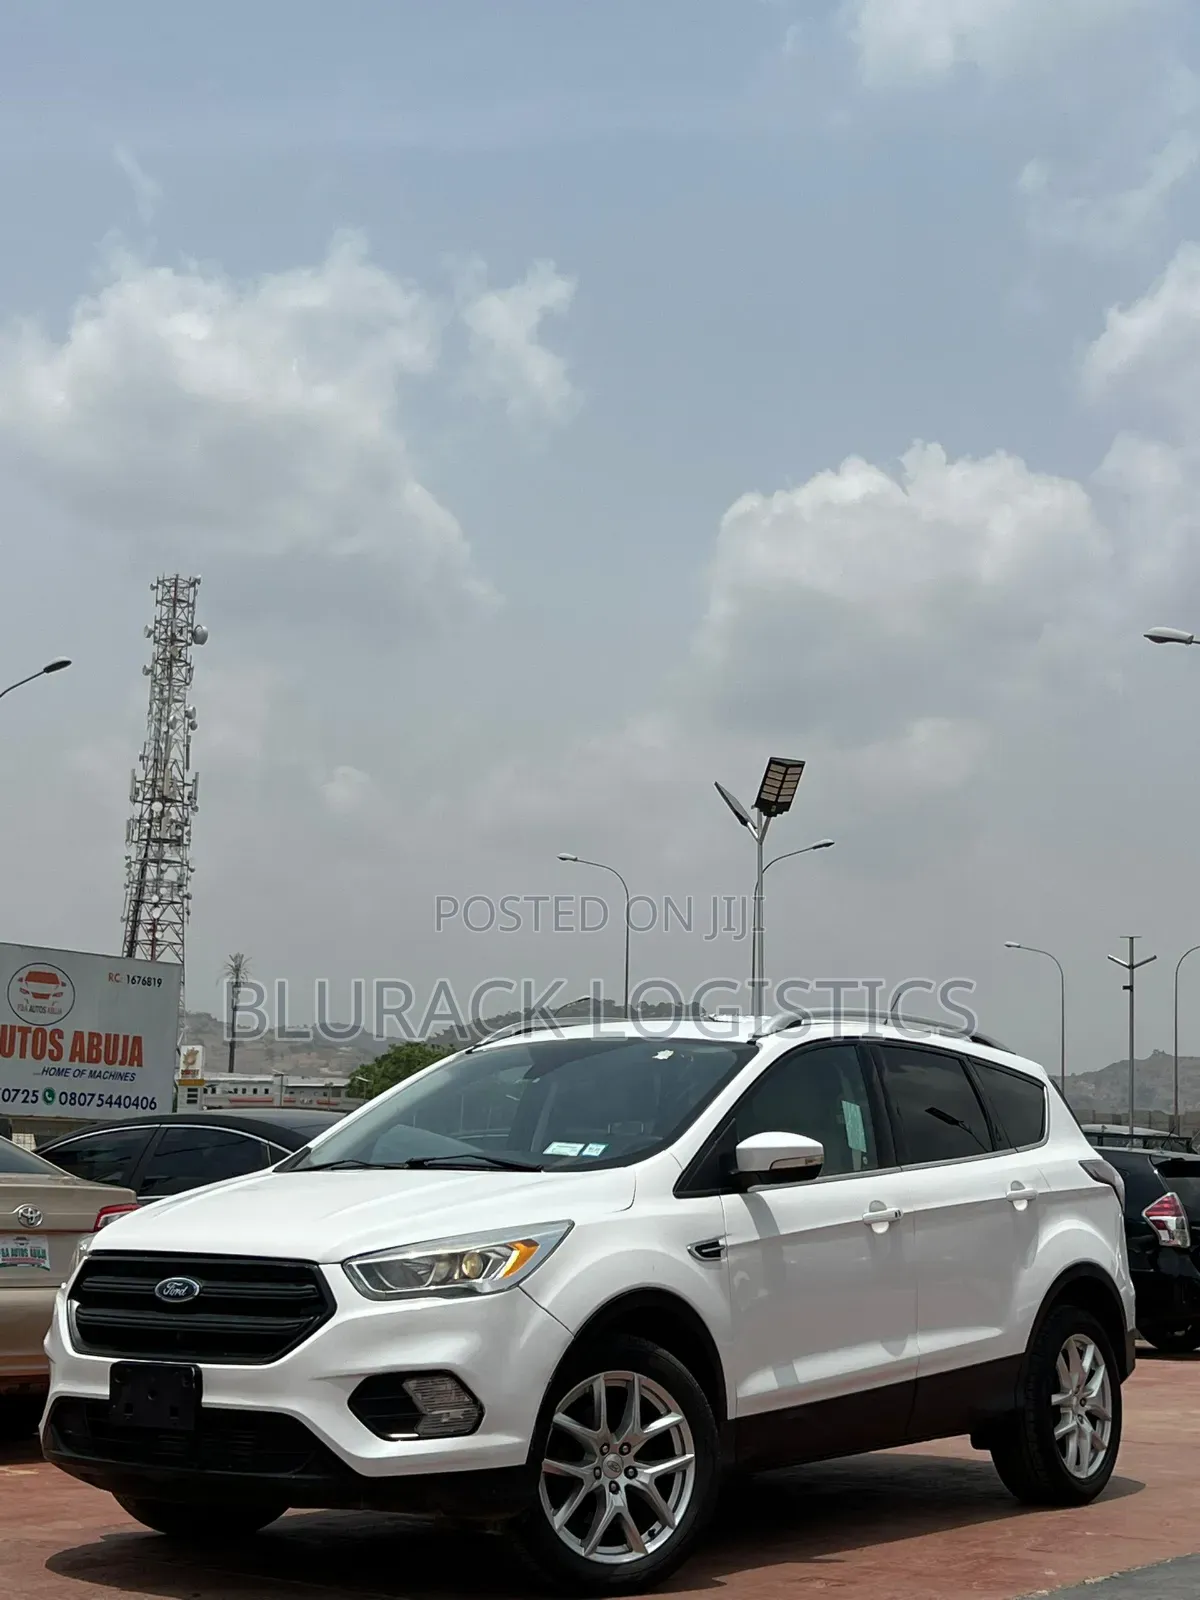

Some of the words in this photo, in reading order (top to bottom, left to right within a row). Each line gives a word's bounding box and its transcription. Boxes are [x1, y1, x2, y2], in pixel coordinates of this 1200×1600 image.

[126, 974, 163, 988] 1676819
[0, 1023, 64, 1062] UTOS
[68, 1030, 144, 1068] ABUJA
[72, 1068, 87, 1079] OF
[87, 1069, 137, 1082] MACHINES
[0, 1087, 39, 1104] 0725
[58, 1091, 157, 1111] 08075440406
[162, 1281, 189, 1297] Ford
